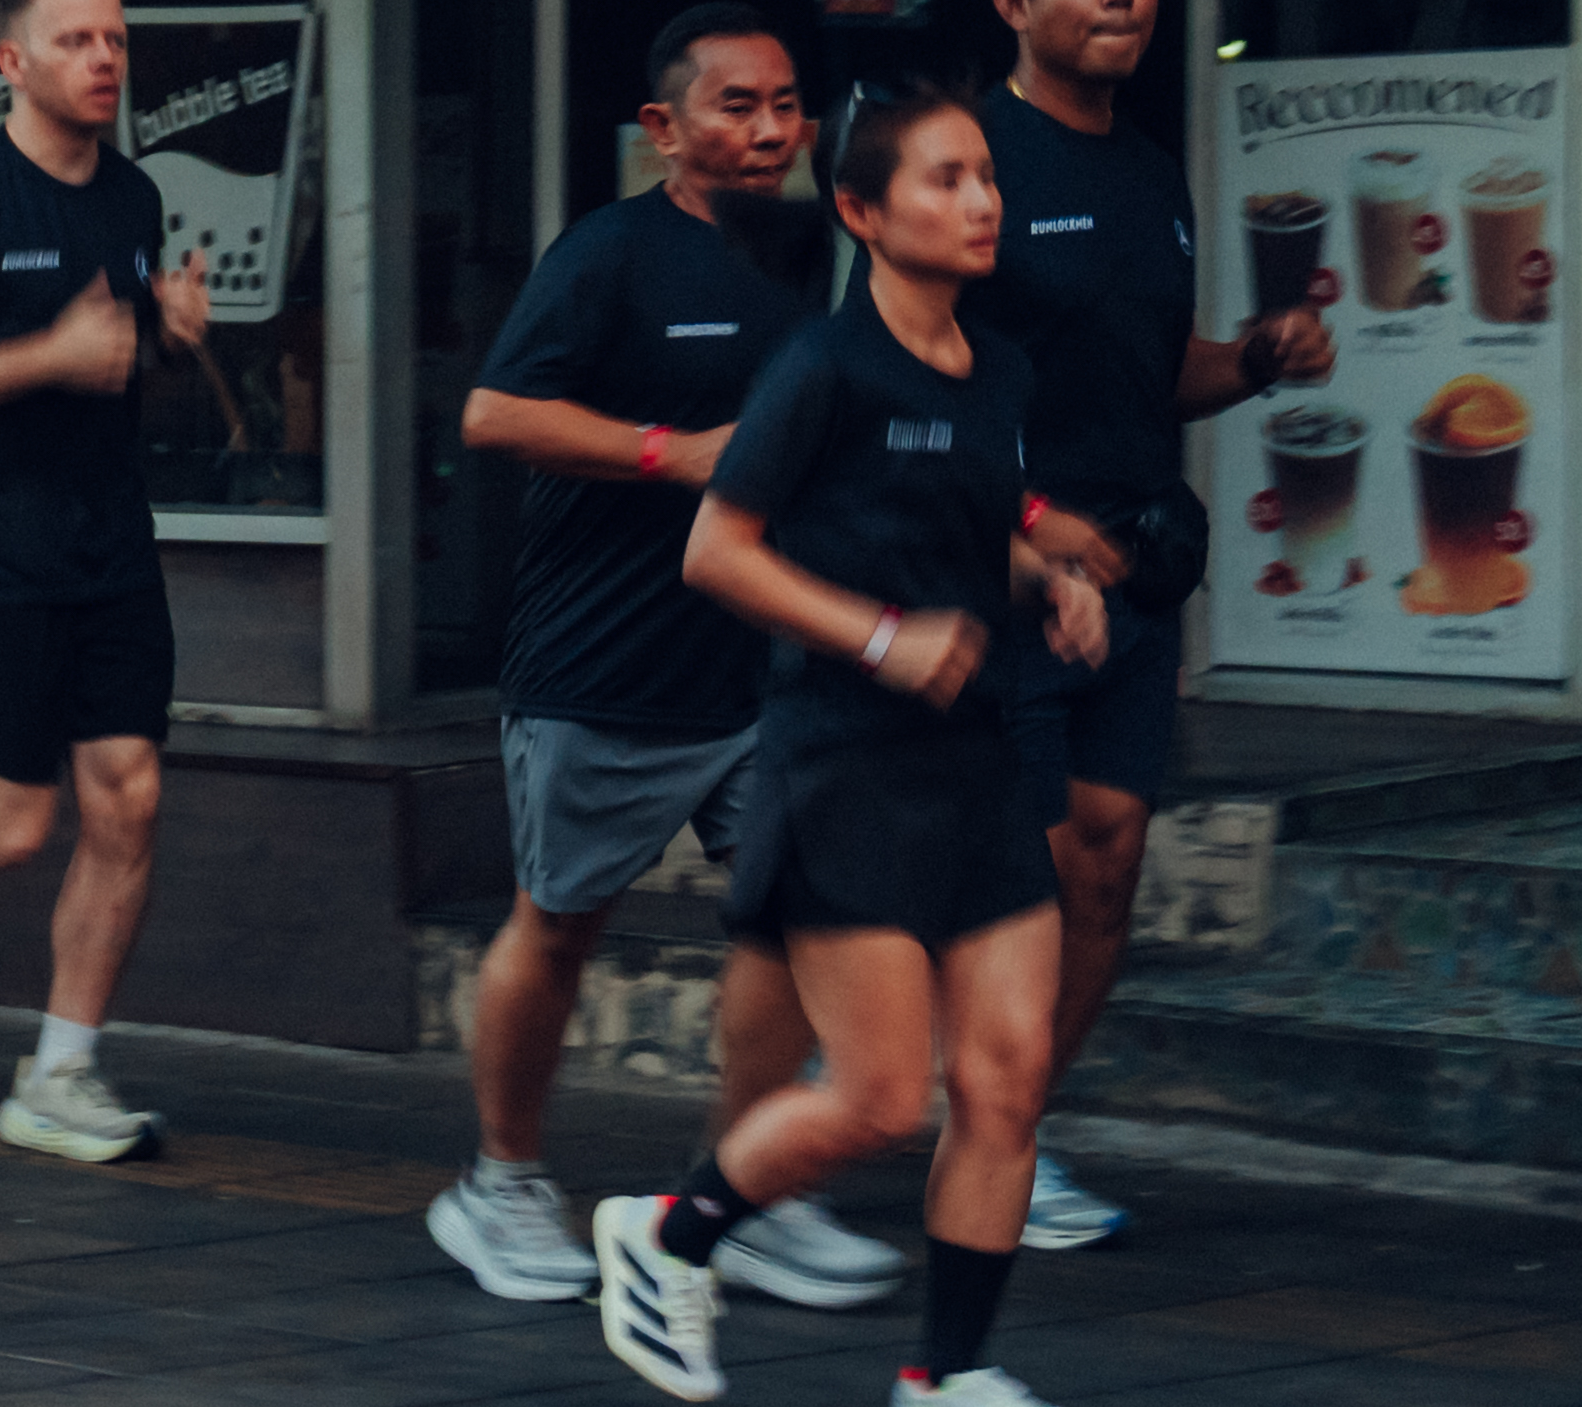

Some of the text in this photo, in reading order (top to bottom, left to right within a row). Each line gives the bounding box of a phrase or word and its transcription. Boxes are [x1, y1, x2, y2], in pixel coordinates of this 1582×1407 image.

[133, 58, 292, 148] bubble tea
[1030, 213, 1094, 235] RUNLOCKMEN
